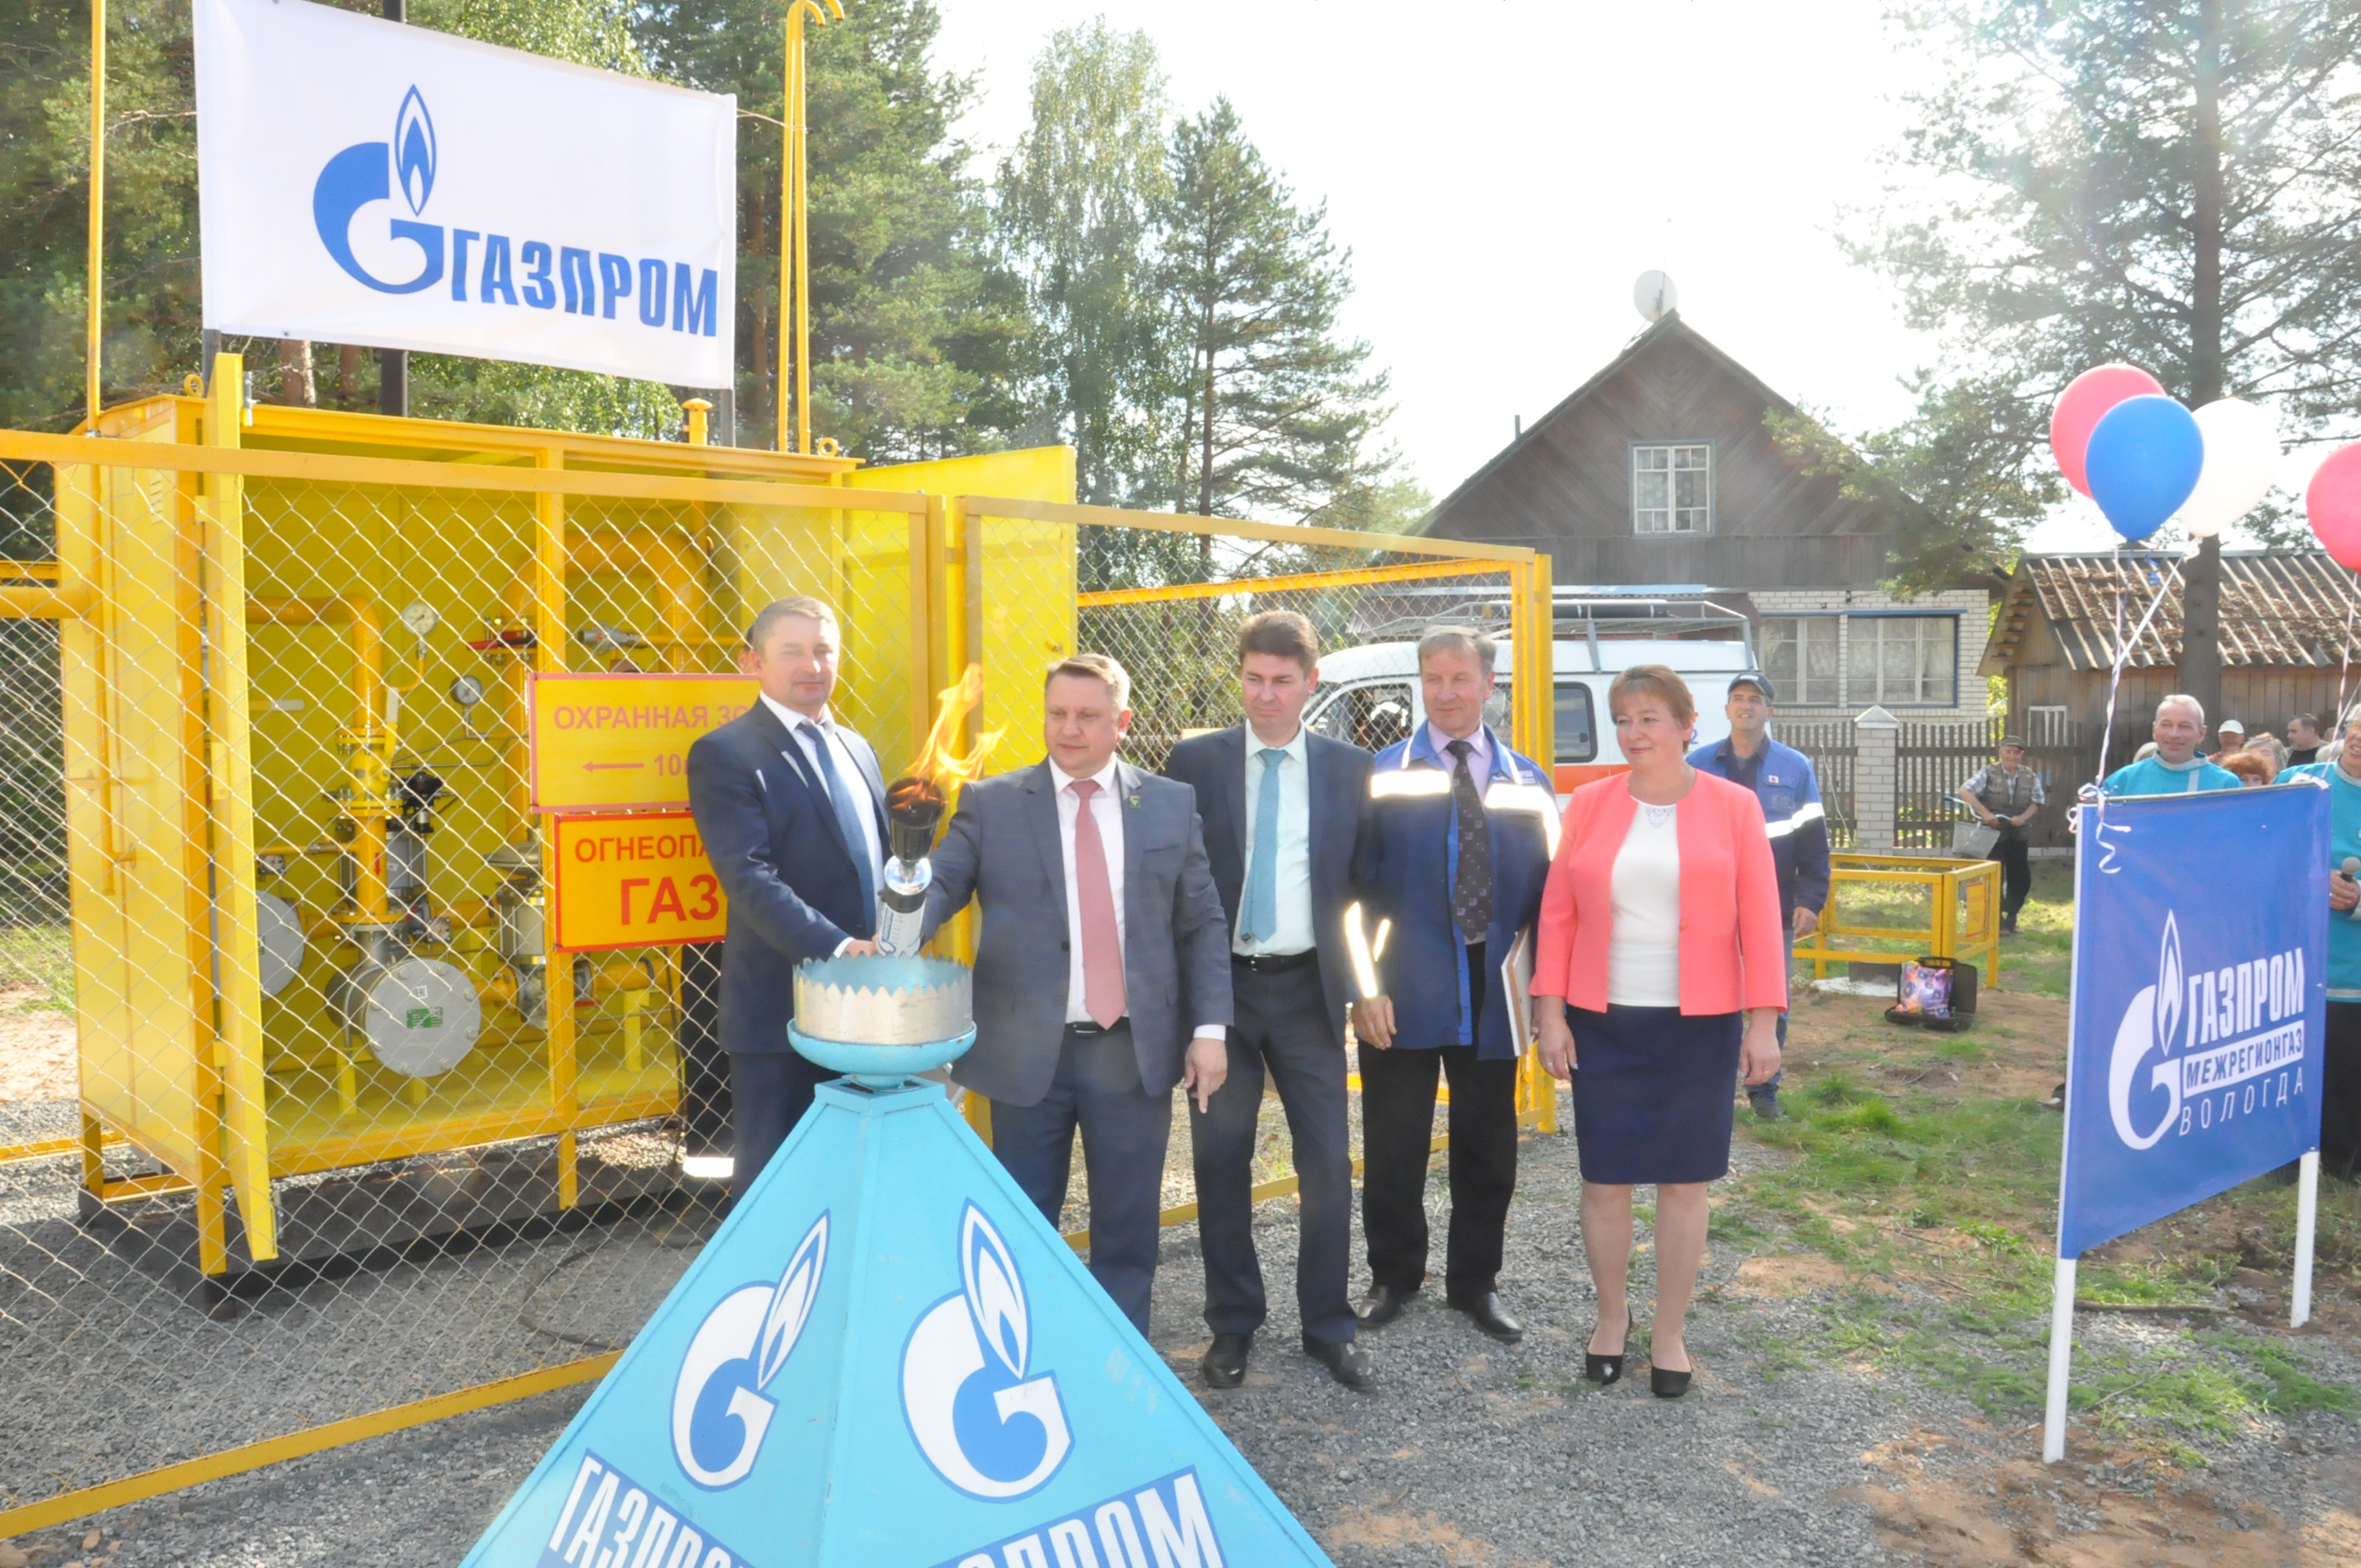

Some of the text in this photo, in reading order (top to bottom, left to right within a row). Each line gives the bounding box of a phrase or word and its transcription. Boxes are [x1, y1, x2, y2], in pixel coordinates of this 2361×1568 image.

[451, 228, 718, 338] ГАЗПРОМ
[554, 705, 709, 730] ОХРАННАЯ
[575, 834, 706, 863] ОГНЕОП
[620, 874, 719, 926] ГАЗ
[2186, 947, 2304, 1048] ГАЗПРОМ
[2186, 1027, 2303, 1089] МЕЖРЕГИОНГАЗ
[2179, 1067, 2304, 1136] ВОЛОГДА
